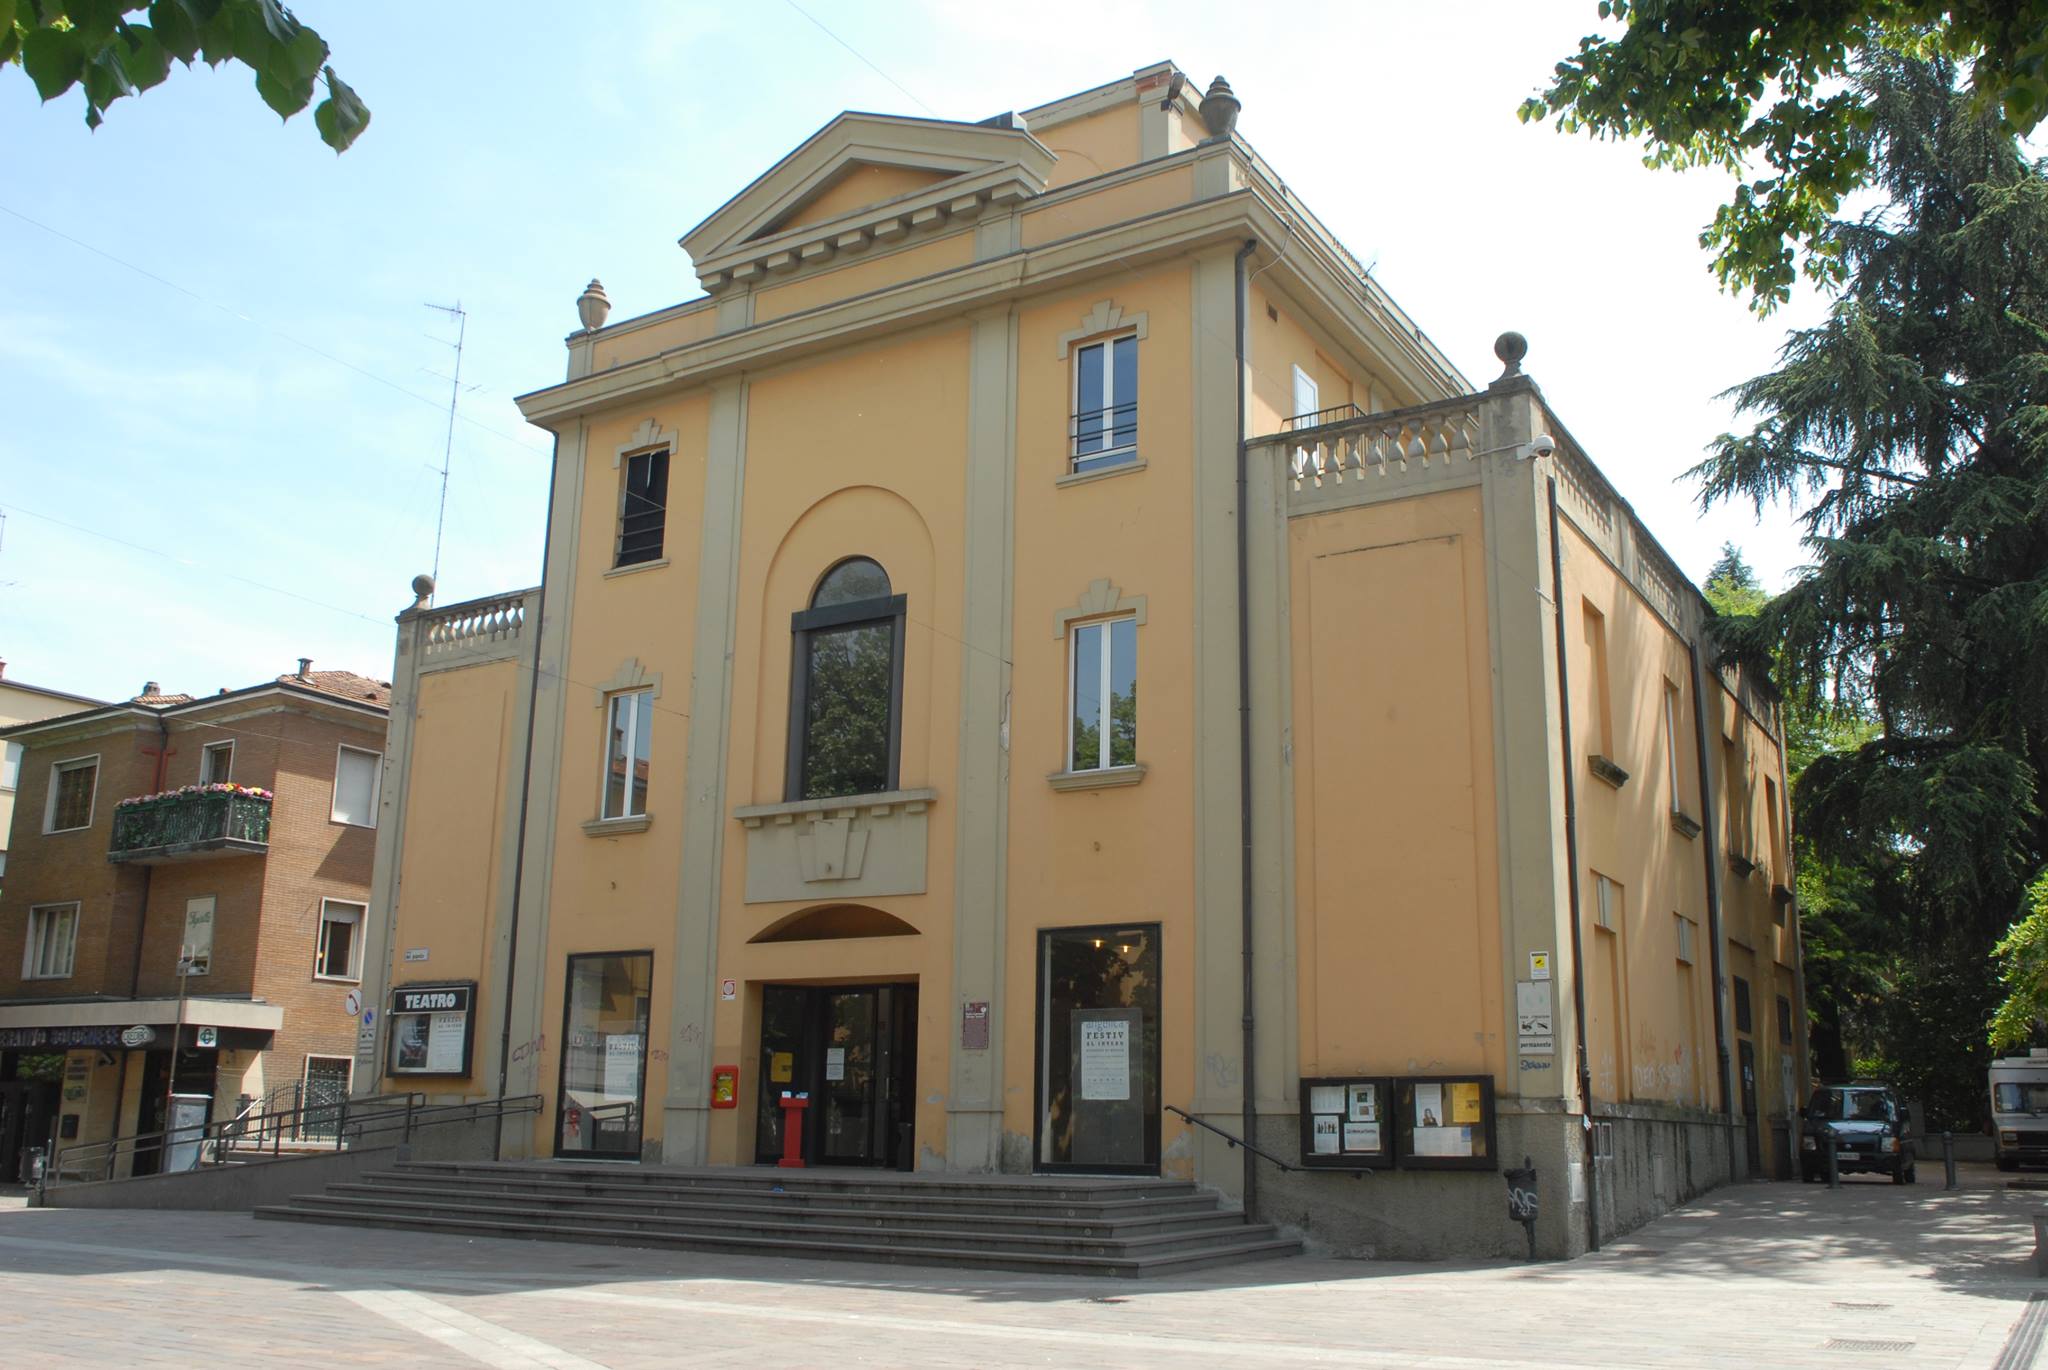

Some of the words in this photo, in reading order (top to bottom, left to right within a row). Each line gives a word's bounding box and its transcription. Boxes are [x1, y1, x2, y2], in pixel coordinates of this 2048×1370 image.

[405, 993, 456, 1009] TEATRO
[1086, 1031, 1124, 1040] FESTIV
[1520, 1041, 1552, 1049] permanente
